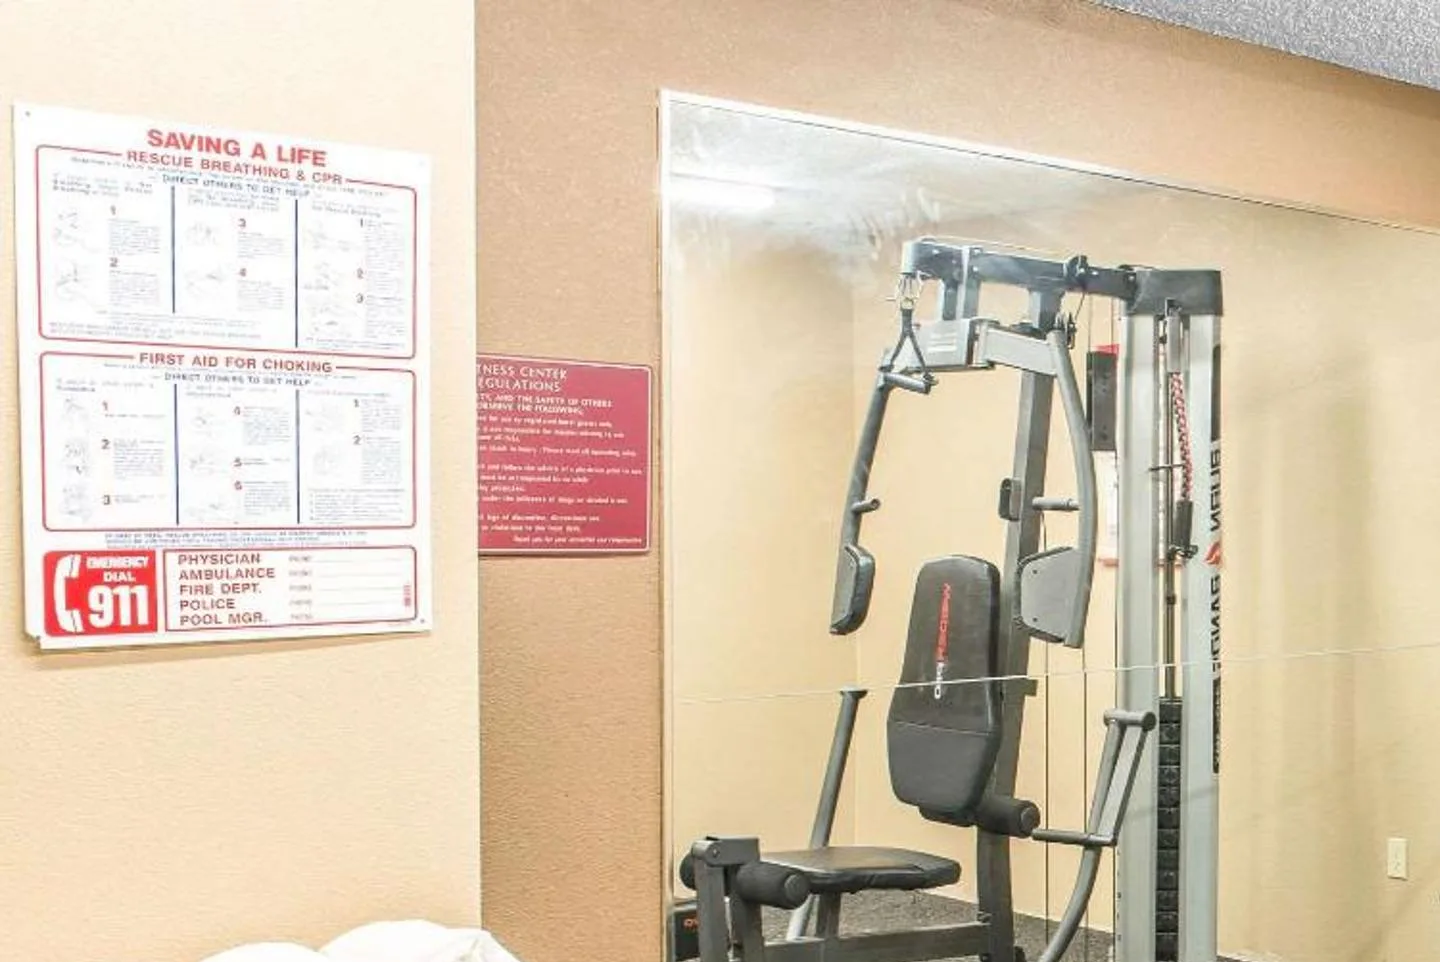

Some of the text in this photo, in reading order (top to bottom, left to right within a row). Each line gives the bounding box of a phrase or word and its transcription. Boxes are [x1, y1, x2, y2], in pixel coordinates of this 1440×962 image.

[147, 128, 328, 168] SAVING A LIFE
[127, 150, 194, 169] RESCUE
[200, 158, 290, 180] BREATHING
[296, 170, 306, 182] &
[312, 172, 343, 185] CPR
[139, 352, 333, 373] FIRST AID FOR CHOKING
[519, 366, 568, 380] CENTER
[477, 377, 562, 393] EGULATIONS
[101, 438, 110, 450] 2
[178, 553, 261, 566] PHYSICIAN
[104, 571, 136, 582] DIAL
[178, 567, 276, 581] AMBULANCE
[180, 582, 262, 596] FIRE DEPT.
[88, 585, 149, 629] 911
[180, 598, 235, 611] POLICE
[180, 611, 269, 626] POOL MGR.
